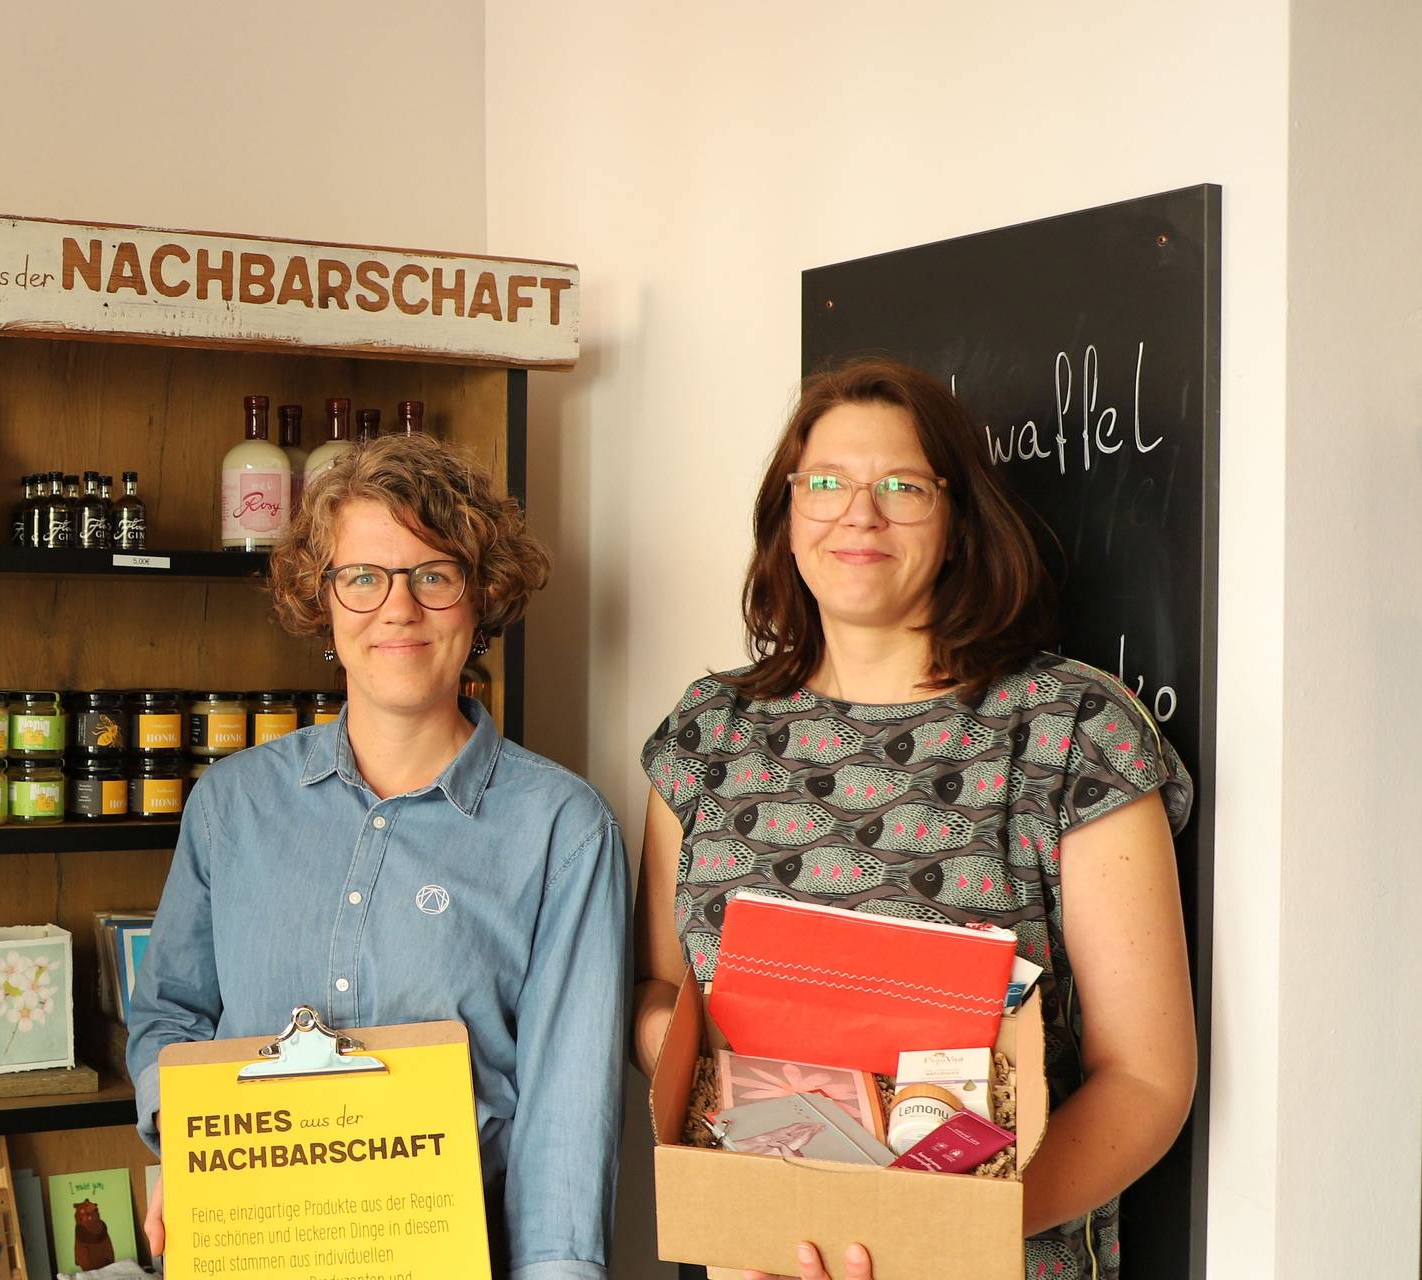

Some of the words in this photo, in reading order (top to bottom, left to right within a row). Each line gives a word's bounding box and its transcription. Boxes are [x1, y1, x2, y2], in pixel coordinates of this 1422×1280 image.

[15, 254, 55, 289] der
[62, 237, 571, 326] NACHBARSCHAFT
[950, 341, 1163, 475] waffel
[232, 491, 282, 519] Rosy
[186, 1109, 293, 1138] FEINES
[300, 1116, 330, 1129] aus
[336, 1104, 364, 1128] der
[898, 1104, 949, 1122] Lemony
[188, 1133, 445, 1173] NACHBARSCHAFT
[191, 1206, 226, 1225] Feine,
[229, 1202, 300, 1222] einzigartige
[304, 1198, 357, 1217] Produkte
[360, 1199, 382, 1213] aus
[386, 1194, 406, 1211] der
[192, 1231, 211, 1248] Die
[214, 1227, 264, 1247] schönen
[268, 1226, 291, 1244] und
[294, 1223, 346, 1243] leckeren
[350, 1220, 385, 1242] Dinge
[388, 1220, 400, 1236] in
[404, 1217, 449, 1236] diesem
[193, 1257, 226, 1276] Regal
[229, 1253, 286, 1272] stammen
[289, 1252, 311, 1268] aus
[314, 1246, 394, 1267] individuellen
